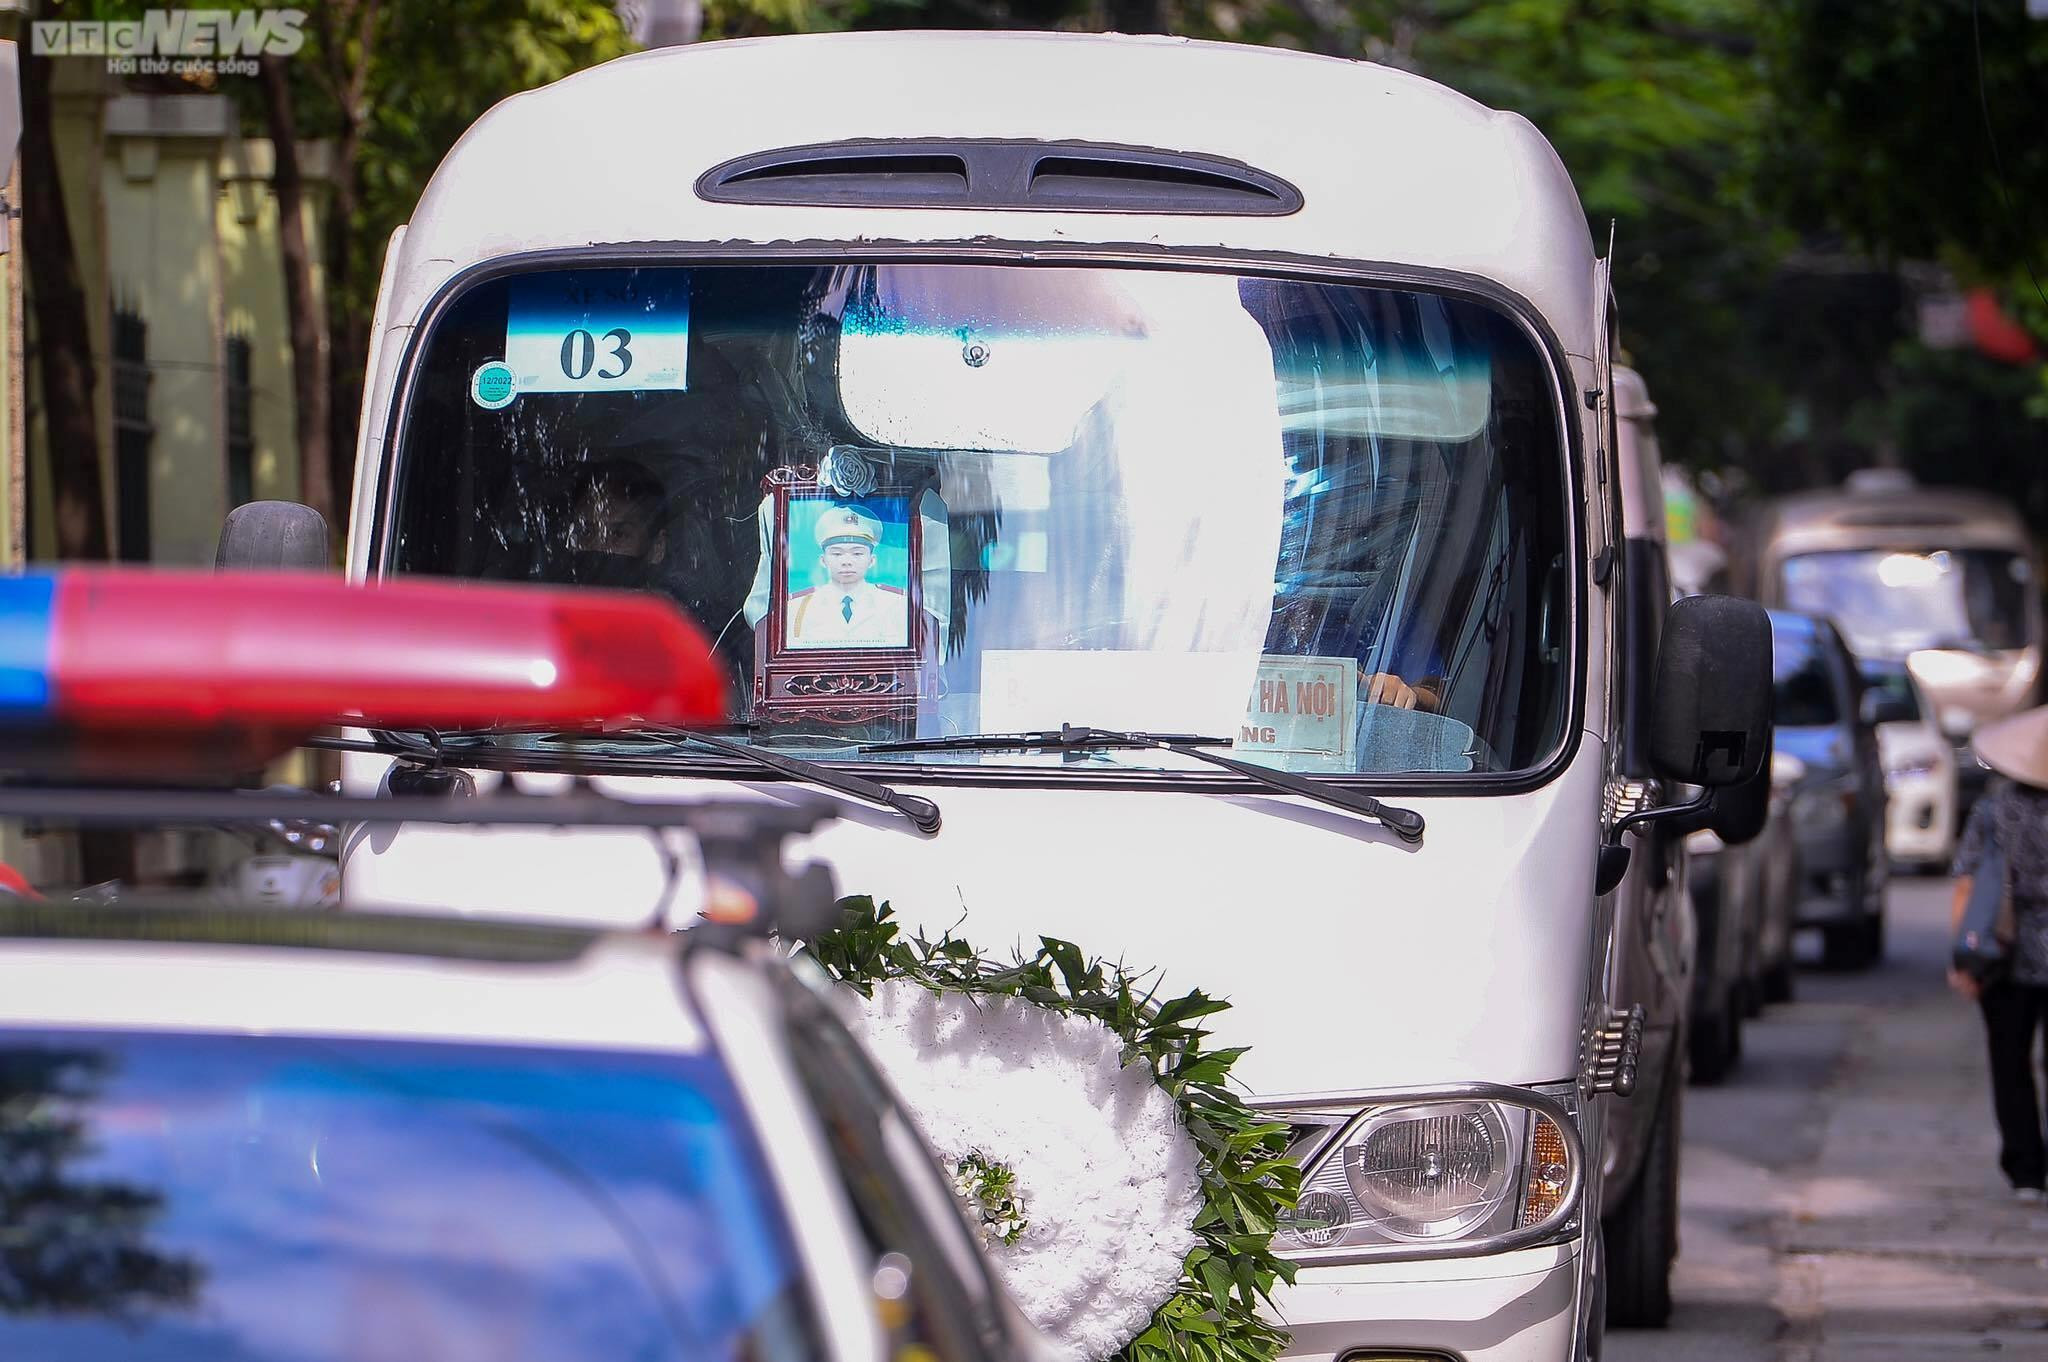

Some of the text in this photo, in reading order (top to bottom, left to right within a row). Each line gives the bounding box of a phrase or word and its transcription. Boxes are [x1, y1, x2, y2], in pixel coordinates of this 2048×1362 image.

[561, 328, 633, 380] 03
[482, 376, 512, 385] 12/2022
[1259, 673, 1289, 714] HÀ
[1296, 674, 1336, 722] NỘI
[1237, 725, 1276, 744] NG
